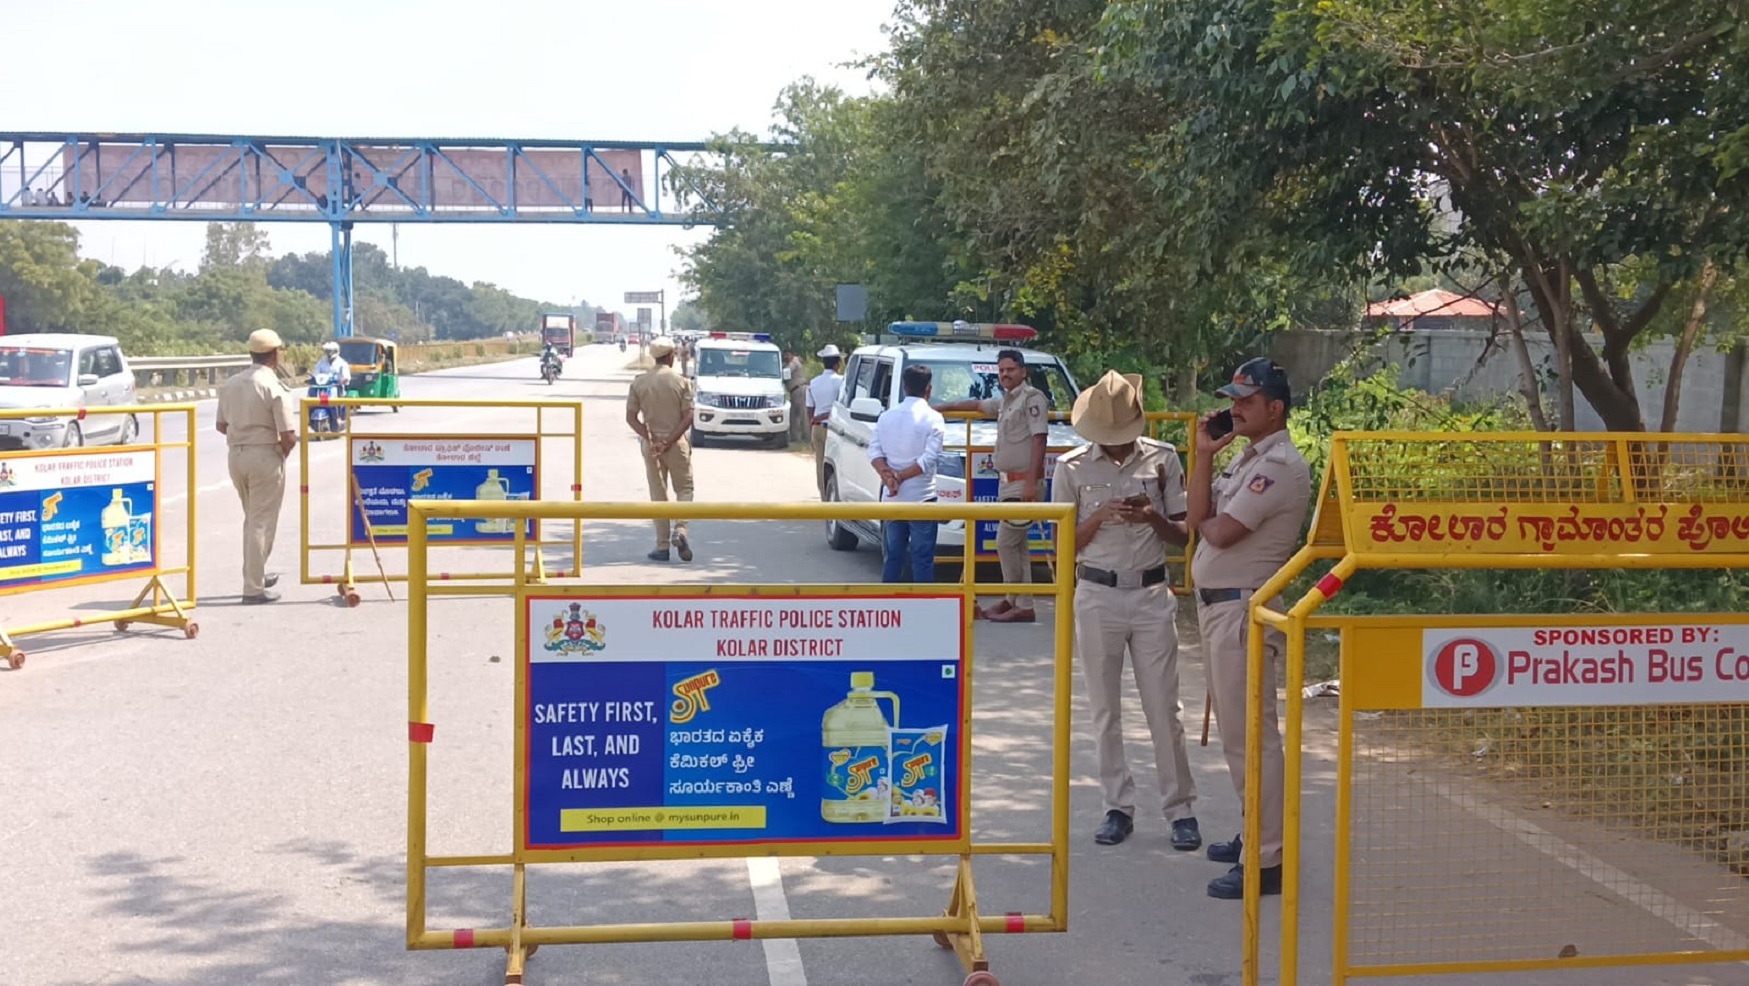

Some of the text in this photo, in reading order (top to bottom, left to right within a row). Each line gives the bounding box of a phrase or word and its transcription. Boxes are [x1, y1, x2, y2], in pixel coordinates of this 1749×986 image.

[1370, 503, 1508, 543] ಕೋಲಾರ
[652, 609, 902, 629] KOLAR TRAFFIC POLICE STATION
[1533, 627, 1719, 645] SPONSORED BY:
[716, 639, 843, 656] KOLAR DISTRICT
[1508, 650, 1634, 684] Prakash
[1649, 649, 1703, 682] Bus
[535, 701, 658, 725] SAFETY FIRST,
[552, 735, 640, 757] LAST, AND
[669, 728, 764, 749] ಭಾರತದ ಏಕೈಕ
[669, 753, 756, 774] ಕೆಮಿಕಲ್ ಫ್ರೀ
[561, 768, 630, 789] ALWAYS
[669, 777, 795, 799] ಸೂರ್ಯಕಾಂತಿ ಎಣ್ಣೆ
[586, 811, 740, 826] Shop online @ mysunpure.in
